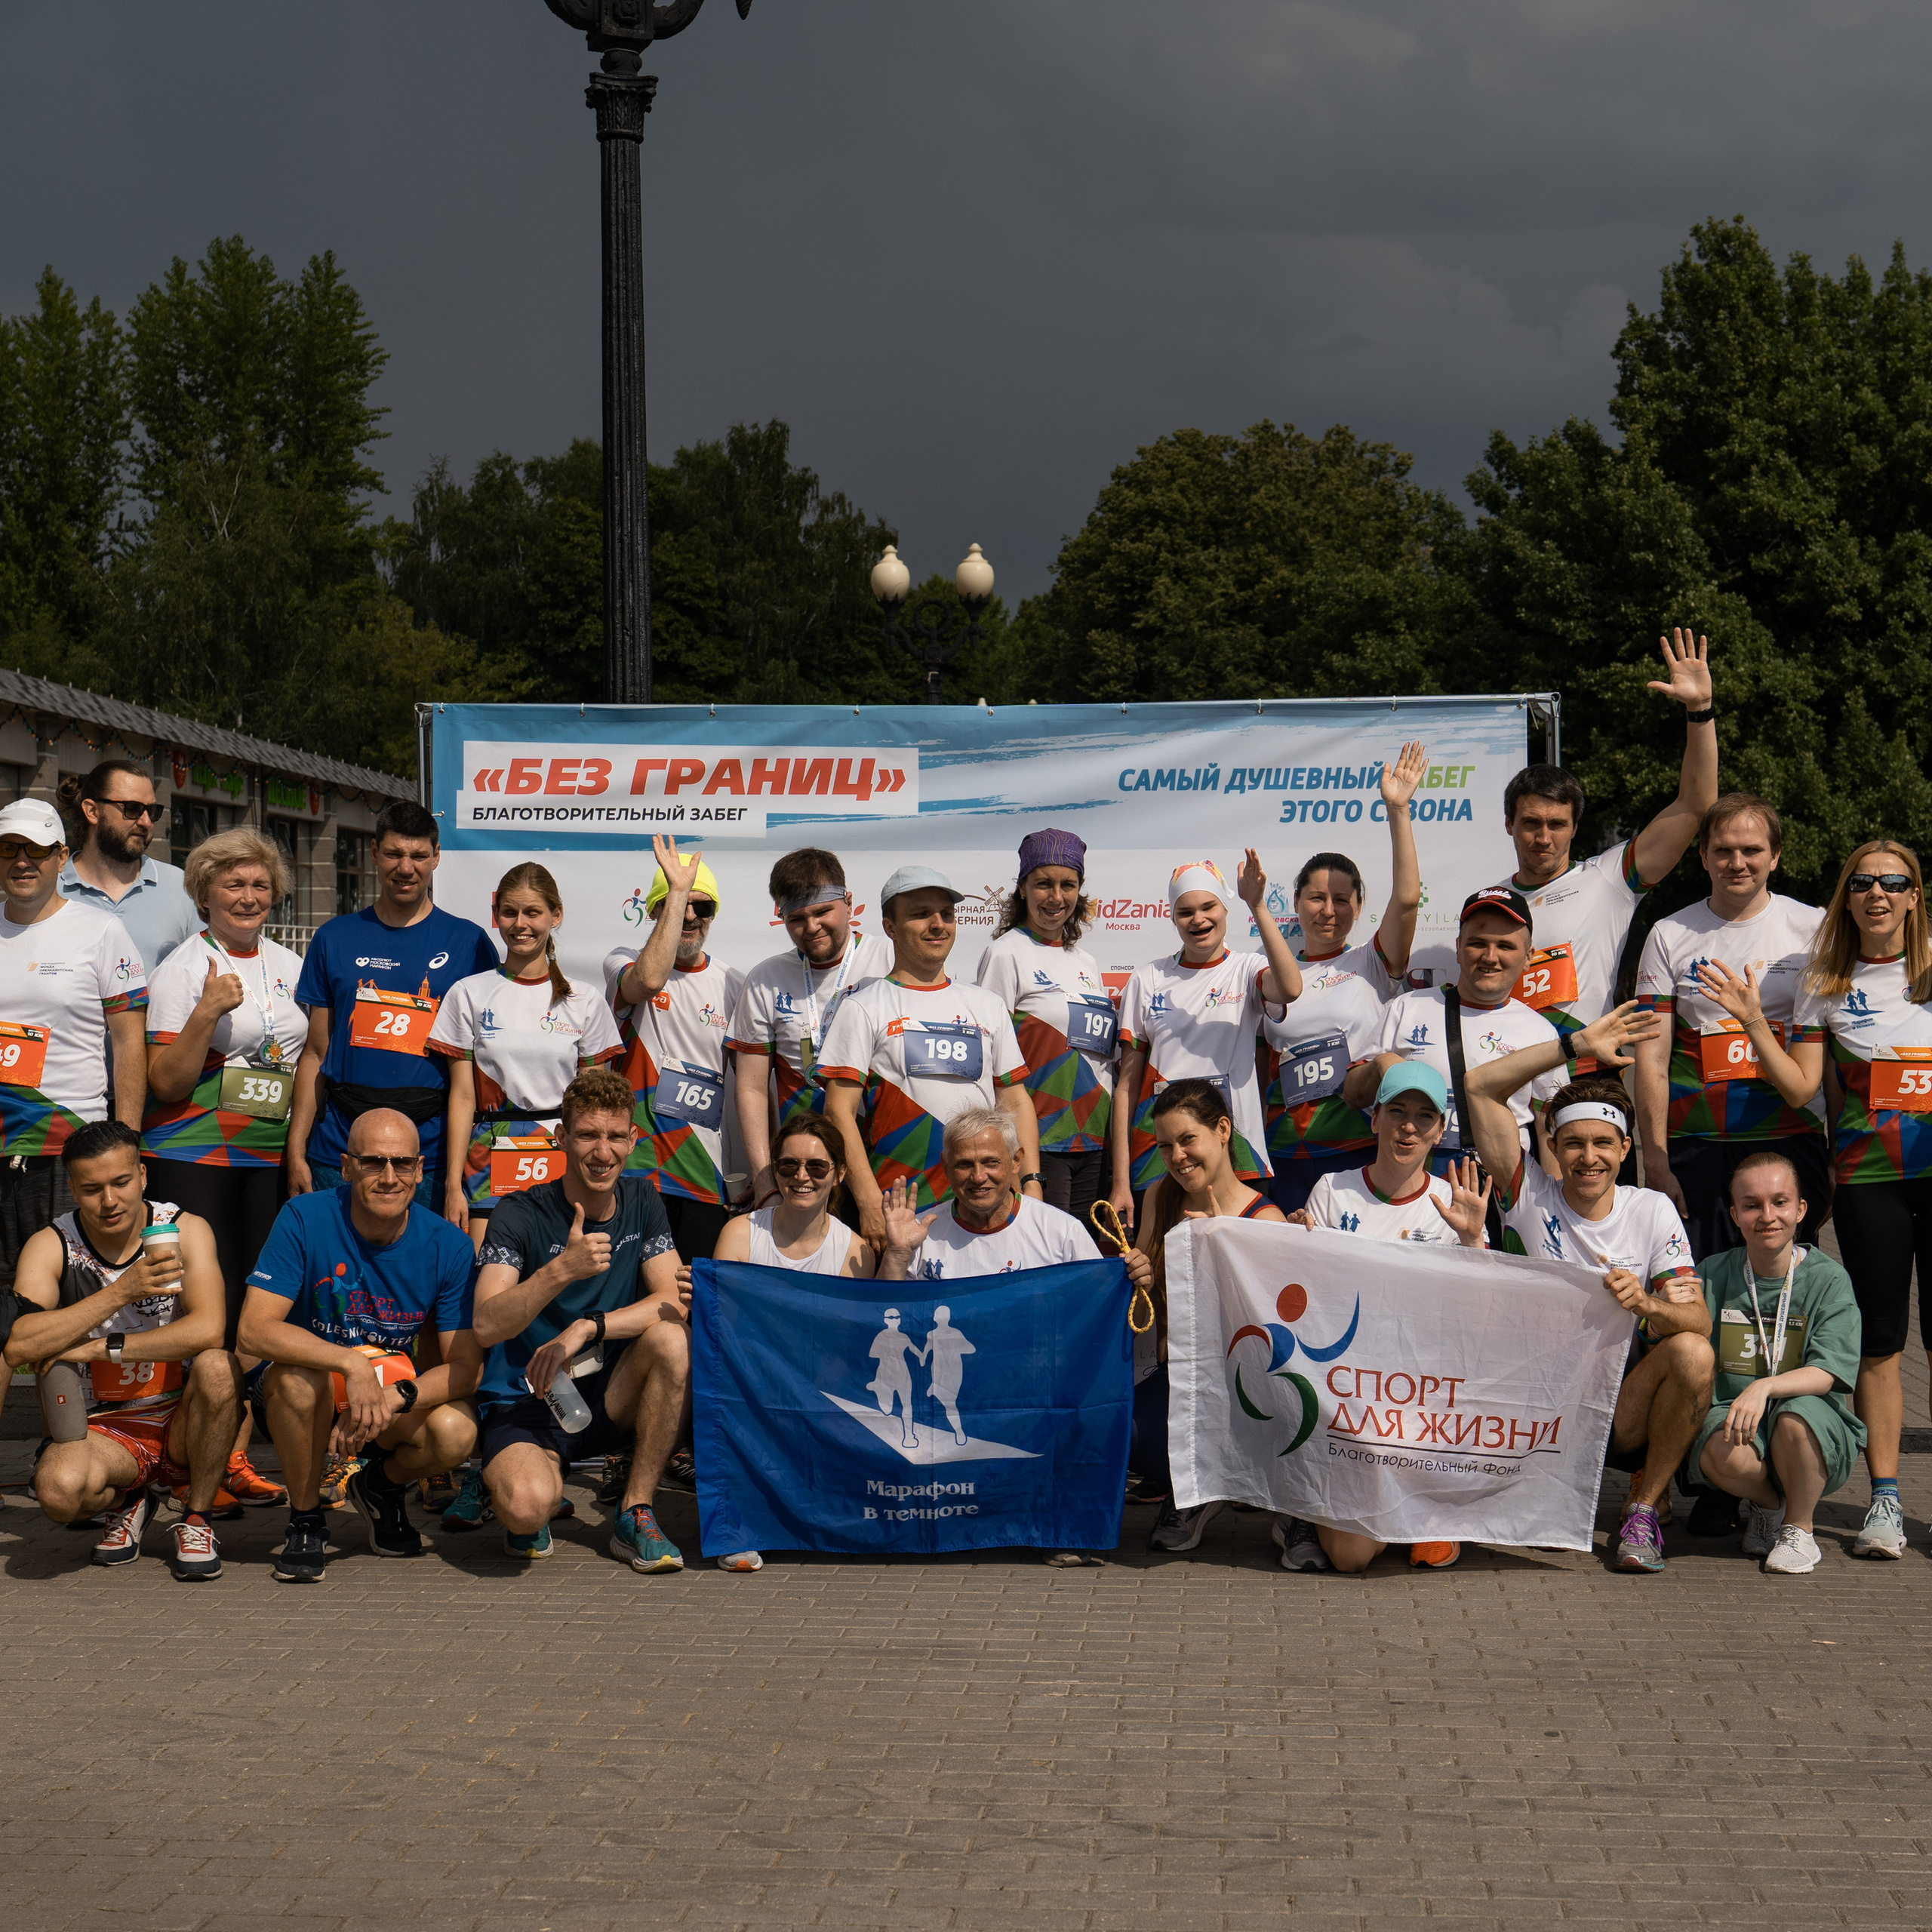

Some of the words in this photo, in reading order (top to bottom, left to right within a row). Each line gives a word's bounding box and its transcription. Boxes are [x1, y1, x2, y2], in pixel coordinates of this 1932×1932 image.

[473, 758, 612, 795] «БЕЗ
[630, 758, 906, 802] ГРАНИЦ»
[1118, 764, 1220, 792] САМЫЙ
[1224, 761, 1384, 795] ДУШЕВНЫЙ
[1418, 765, 1475, 789] БЕГ
[472, 805, 685, 821] БЛАГОТВОРИТЕЛЬНЫЙ
[690, 807, 748, 822] ЗАБЕГ
[1279, 800, 1358, 823] ЭТОГО
[1370, 798, 1472, 823] СЗОНА
[954, 906, 985, 914] ЫРНАЯ
[1091, 898, 1171, 918] idZania
[955, 916, 994, 926] ЕРНИЯ
[1106, 922, 1140, 931] Москва
[1249, 924, 1303, 939] ВДА
[1523, 968, 1551, 997] 52
[374, 1011, 411, 1036] 28
[1084, 1012, 1113, 1039] 197
[924, 1038, 968, 1062] 198
[1294, 1056, 1334, 1088] 195
[1897, 1069, 1932, 1094] 53
[238, 1077, 283, 1103] 339
[675, 1081, 716, 1111] 165
[515, 1157, 549, 1181] 56
[346, 1303, 374, 1315] ДЛЯ
[349, 1291, 395, 1309] СПОРТ
[1780, 1293, 1788, 1322] ДУШЕВНЫЙ
[118, 1361, 155, 1386] 38
[1326, 1364, 1466, 1409] СПОРТ
[1327, 1402, 1404, 1440] ДЛЯ
[1414, 1411, 1563, 1451] ЖИЗНИ
[1327, 1441, 1478, 1475] Благотворительный
[1482, 1463, 1521, 1476] Фонд
[866, 1479, 976, 1501] Марафон
[863, 1506, 878, 1520] в
[883, 1503, 980, 1521] темноте
